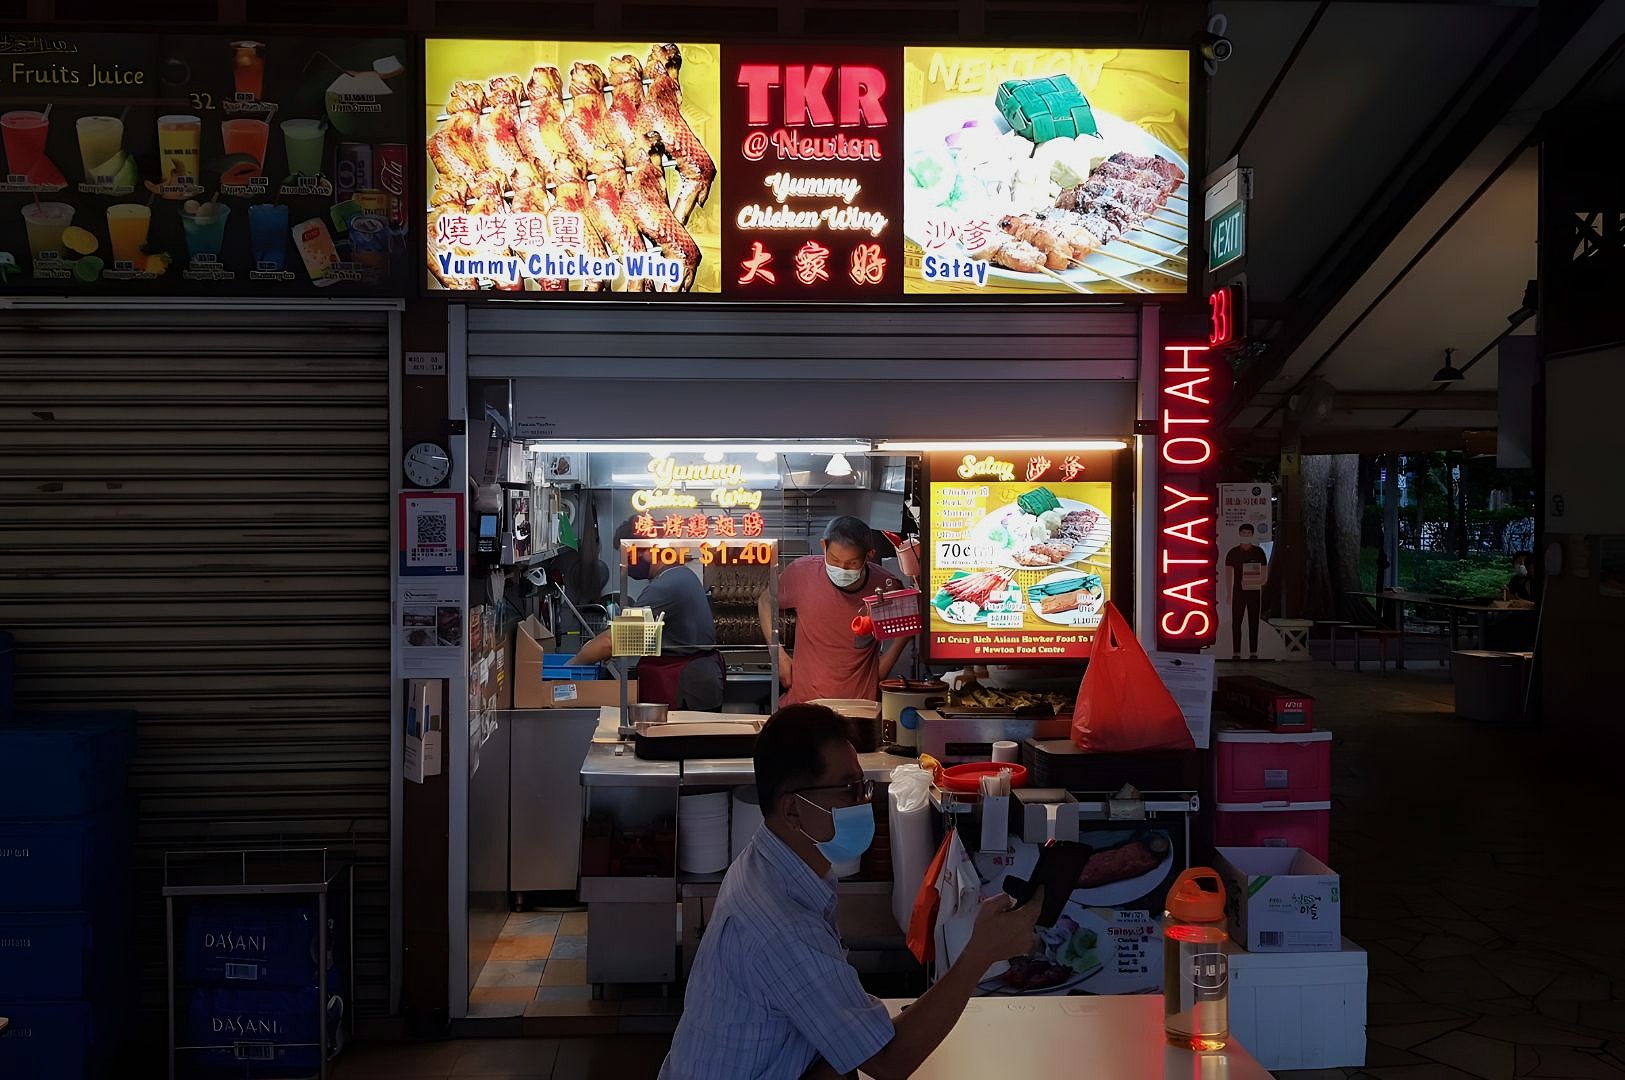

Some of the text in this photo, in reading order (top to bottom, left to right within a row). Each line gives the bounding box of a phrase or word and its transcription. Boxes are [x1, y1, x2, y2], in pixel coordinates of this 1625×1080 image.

[12, 63, 144, 87] Fruits Juice
[191, 92, 215, 110] 32
[737, 64, 888, 128] TKR
[765, 172, 861, 202] Yummy
[736, 205, 888, 236] Chicken Wing
[926, 219, 991, 251] 沙爹
[1217, 212, 1240, 258] EXIT
[438, 252, 681, 282] Yummy Chicken Wing
[738, 241, 886, 285] 大家好
[925, 256, 987, 283] Satay
[647, 457, 747, 489] Yummy
[957, 455, 1015, 481] Satay
[631, 488, 762, 512] Chicken Wing
[1162, 346, 1211, 636] SATAY OTAH
[627, 541, 771, 566] 1 for $1.40
[947, 636, 970, 644] Crazy
[973, 635, 991, 643] Rich
[993, 635, 1019, 643] Asians
[1022, 635, 1053, 643] Hawker
[1056, 635, 1075, 643] Food
[982, 646, 1014, 654] Newton
[1016, 646, 1036, 654] Food
[1038, 646, 1065, 654] Centre
[204, 929, 266, 952] DASANI
[212, 1016, 277, 1036] DASANI
